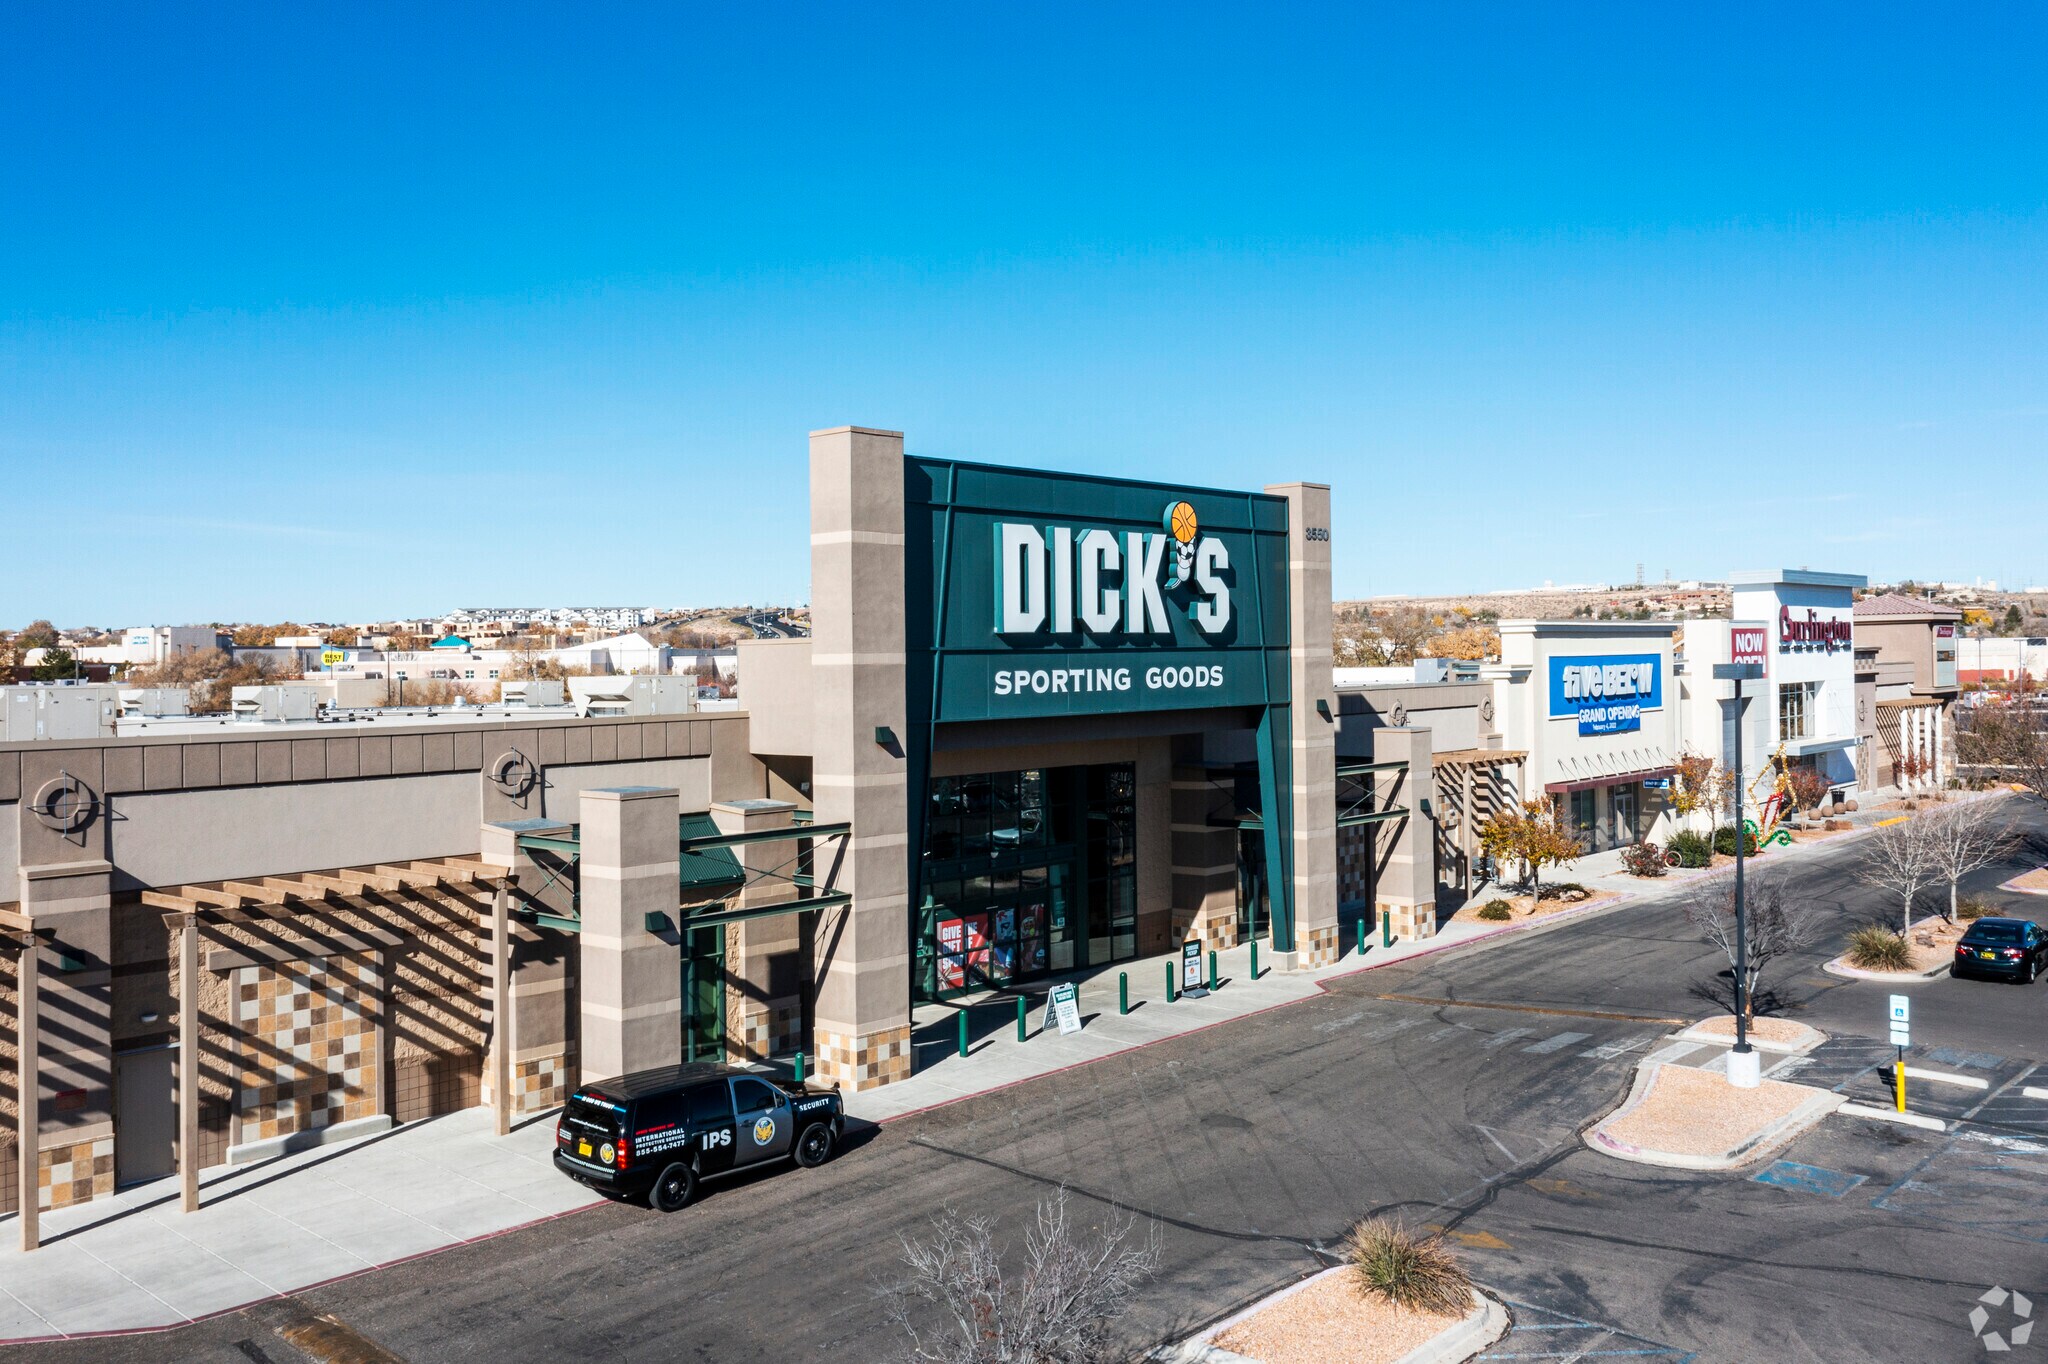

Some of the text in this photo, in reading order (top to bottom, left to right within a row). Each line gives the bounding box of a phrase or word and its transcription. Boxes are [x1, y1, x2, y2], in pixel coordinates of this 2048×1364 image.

[1305, 527, 1329, 541] 3550
[994, 501, 1230, 633] DICK'S
[1779, 605, 1852, 652] Burlington
[1735, 633, 1763, 653] NOW
[994, 665, 1223, 695] SPORTING GOODS
[1579, 704, 1640, 723] GRAND OPENING
[942, 925, 961, 941] GIVE
[942, 939, 961, 955] GIFT
[799, 1098, 829, 1111] SECURITY
[635, 1127, 685, 1144] INTERNATIONAL
[636, 1133, 685, 1149] PROTECTIVE SERVICE
[703, 1129, 732, 1150] IPS
